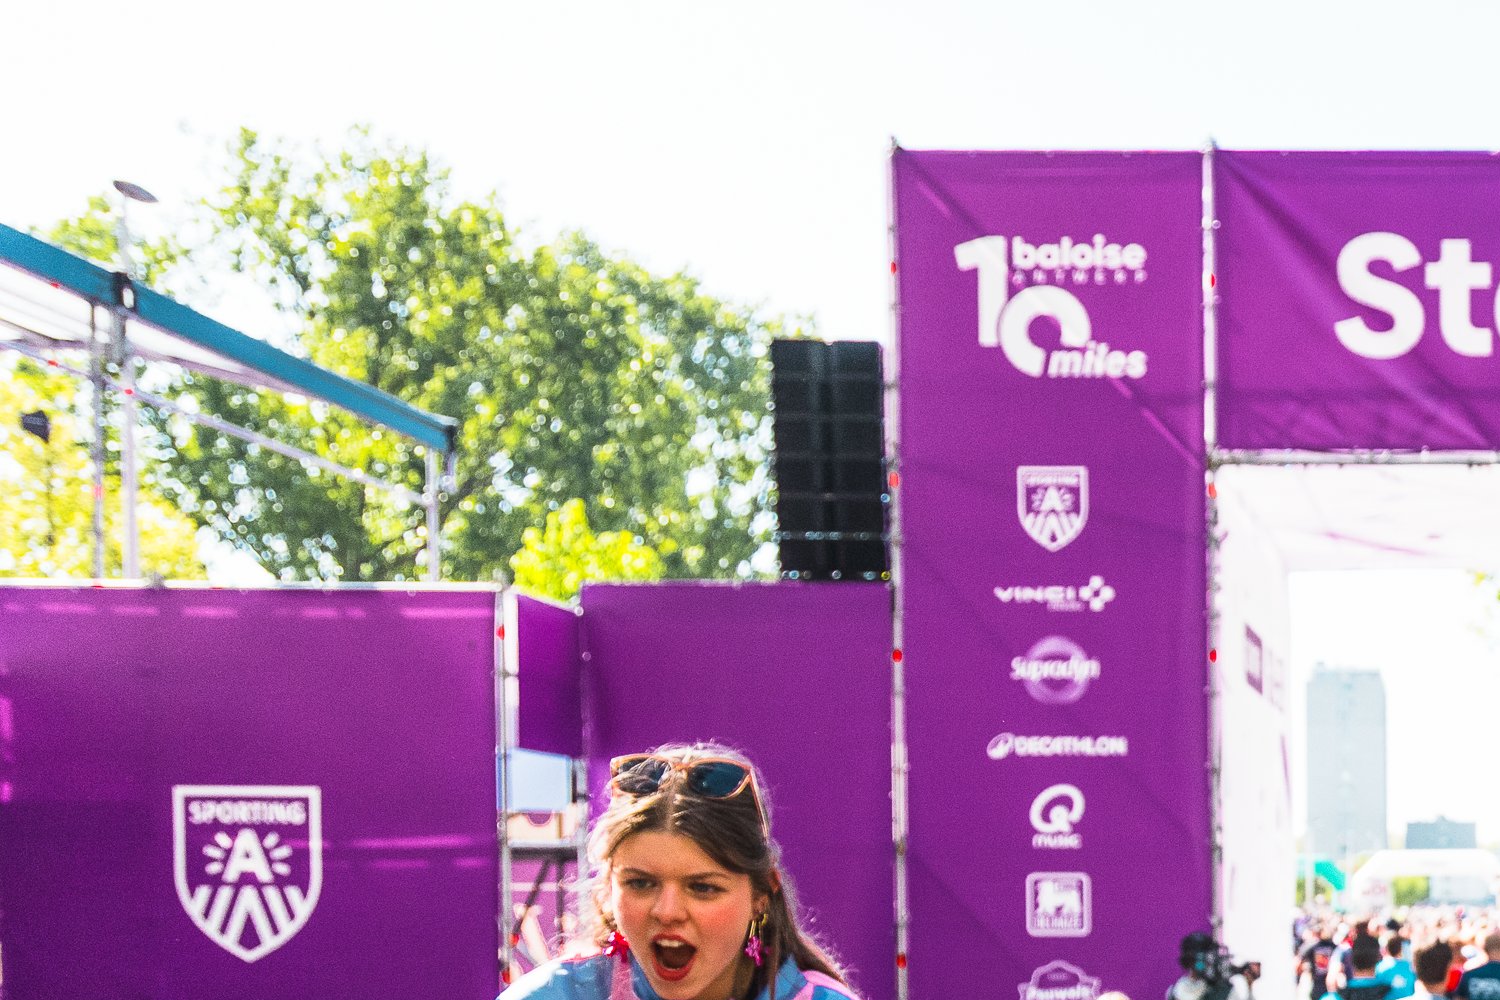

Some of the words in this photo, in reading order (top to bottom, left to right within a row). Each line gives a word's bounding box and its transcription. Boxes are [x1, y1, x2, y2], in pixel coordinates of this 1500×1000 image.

[1011, 233, 1147, 270] baloise
[954, 235, 1092, 378] 10
[1047, 340, 1147, 379] miles
[1014, 735, 1129, 757] DECATHLON
[188, 800, 308, 826] SPORTING
